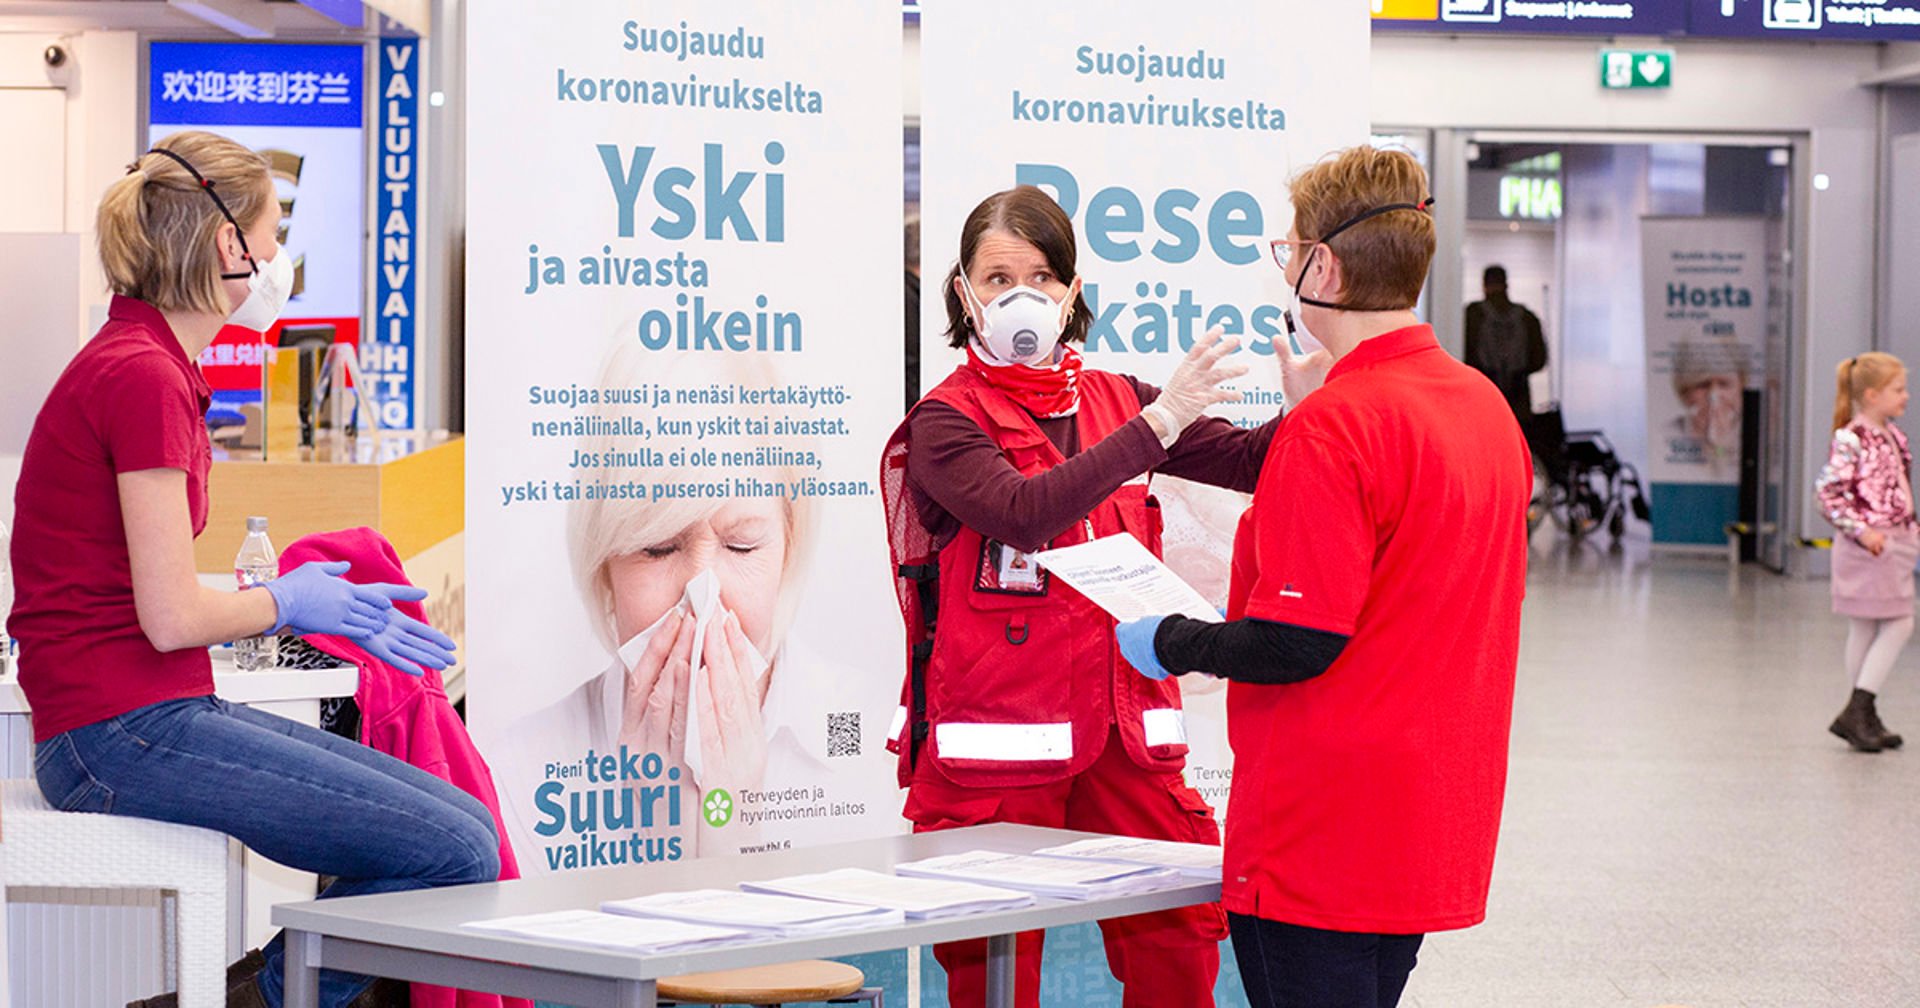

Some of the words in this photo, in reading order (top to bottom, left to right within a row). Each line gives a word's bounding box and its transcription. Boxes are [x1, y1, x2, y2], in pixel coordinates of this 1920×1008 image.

[624, 21, 763, 61] Suojaudu
[1077, 45, 1224, 82] Suojaudu
[162, 70, 351, 103] 欢迎来到芬兰
[558, 69, 822, 113] koronavirukselta
[1013, 91, 1285, 130] koronavirukselta
[596, 141, 785, 243] Yski
[383, 45, 411, 428] VALUUTANVAIHTO
[525, 244, 564, 294] ja
[579, 245, 708, 287] aivasta
[1665, 282, 1752, 308] Hosta
[639, 293, 801, 351] oikein
[530, 384, 599, 407] Suojaa
[604, 385, 647, 404] suusi
[652, 386, 670, 408] ja
[677, 385, 733, 404] nenäsi
[740, 385, 851, 408] kertakäyttö-
[532, 417, 651, 440] nenäliinalla,
[658, 417, 691, 435] kun
[697, 416, 740, 440] yskit
[745, 416, 768, 435] tai
[774, 416, 849, 435] aivastat.
[569, 450, 599, 468] Jos
[604, 448, 663, 467] sinulla
[669, 447, 685, 466] ei
[691, 448, 716, 466] ole
[722, 447, 821, 469] nenäliinaa,
[502, 480, 546, 506] yski
[553, 480, 580, 500] tai
[586, 480, 646, 499] aivasta
[653, 479, 729, 503] puserosi
[735, 478, 786, 499] hihan
[789, 478, 874, 502] yläosaan.
[546, 760, 582, 779] Pieni
[586, 745, 662, 783] teko
[534, 767, 680, 838] Suuri
[739, 787, 808, 805] Terveyden
[811, 786, 824, 803] ja
[740, 807, 826, 825] hyvinvoinnin
[829, 801, 865, 816] laitos
[546, 832, 681, 871] vaikutus
[740, 840, 790, 854] www.thlfi
